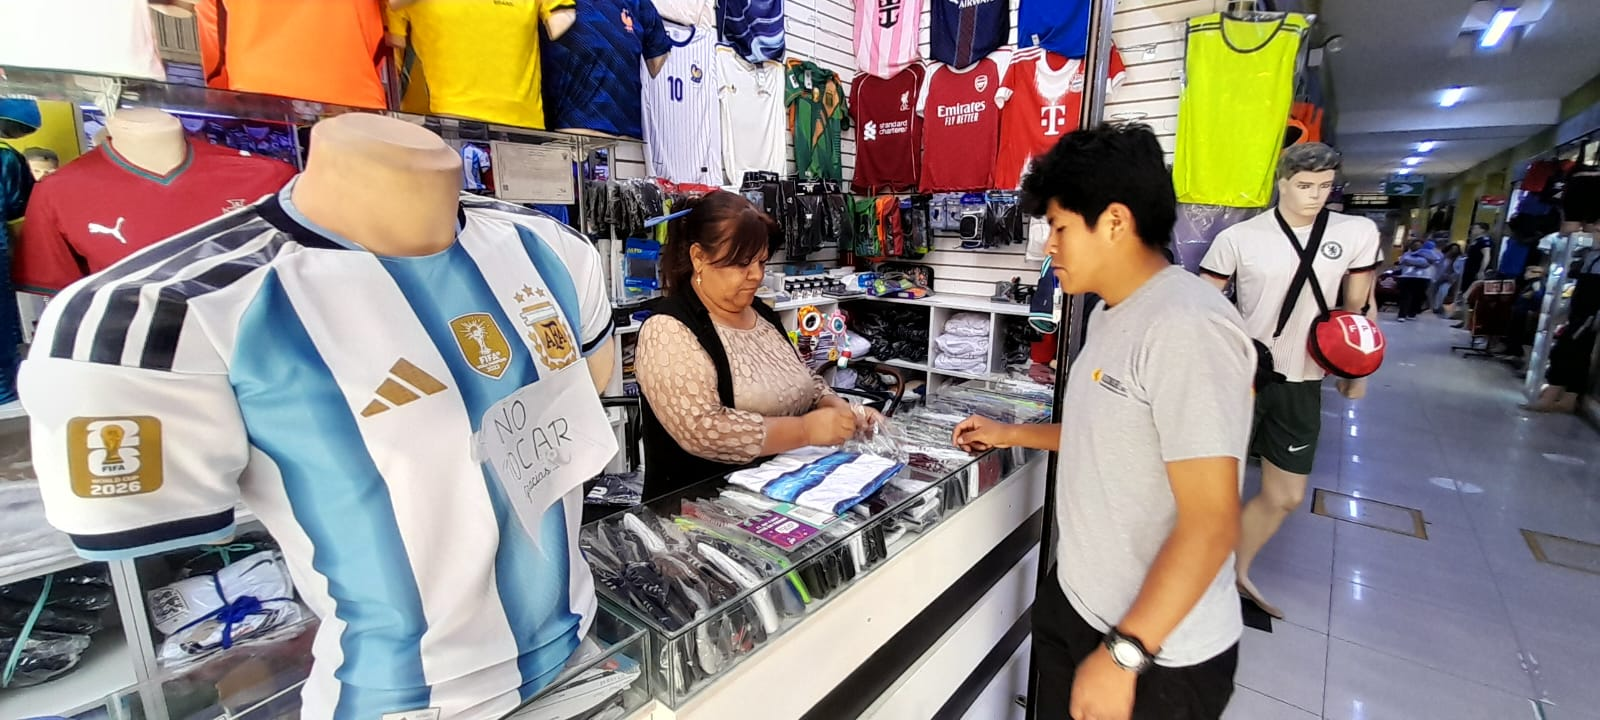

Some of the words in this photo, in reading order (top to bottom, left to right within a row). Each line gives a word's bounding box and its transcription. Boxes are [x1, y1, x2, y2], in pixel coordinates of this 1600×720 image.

[667, 75, 684, 102] 10
[937, 100, 986, 118] Emirates
[879, 119, 908, 130] standard
[944, 115, 956, 126] FLY
[956, 112, 979, 125] BETTER
[494, 399, 527, 445] NO
[503, 417, 573, 481] OCAR
[90, 481, 141, 496] 2026
